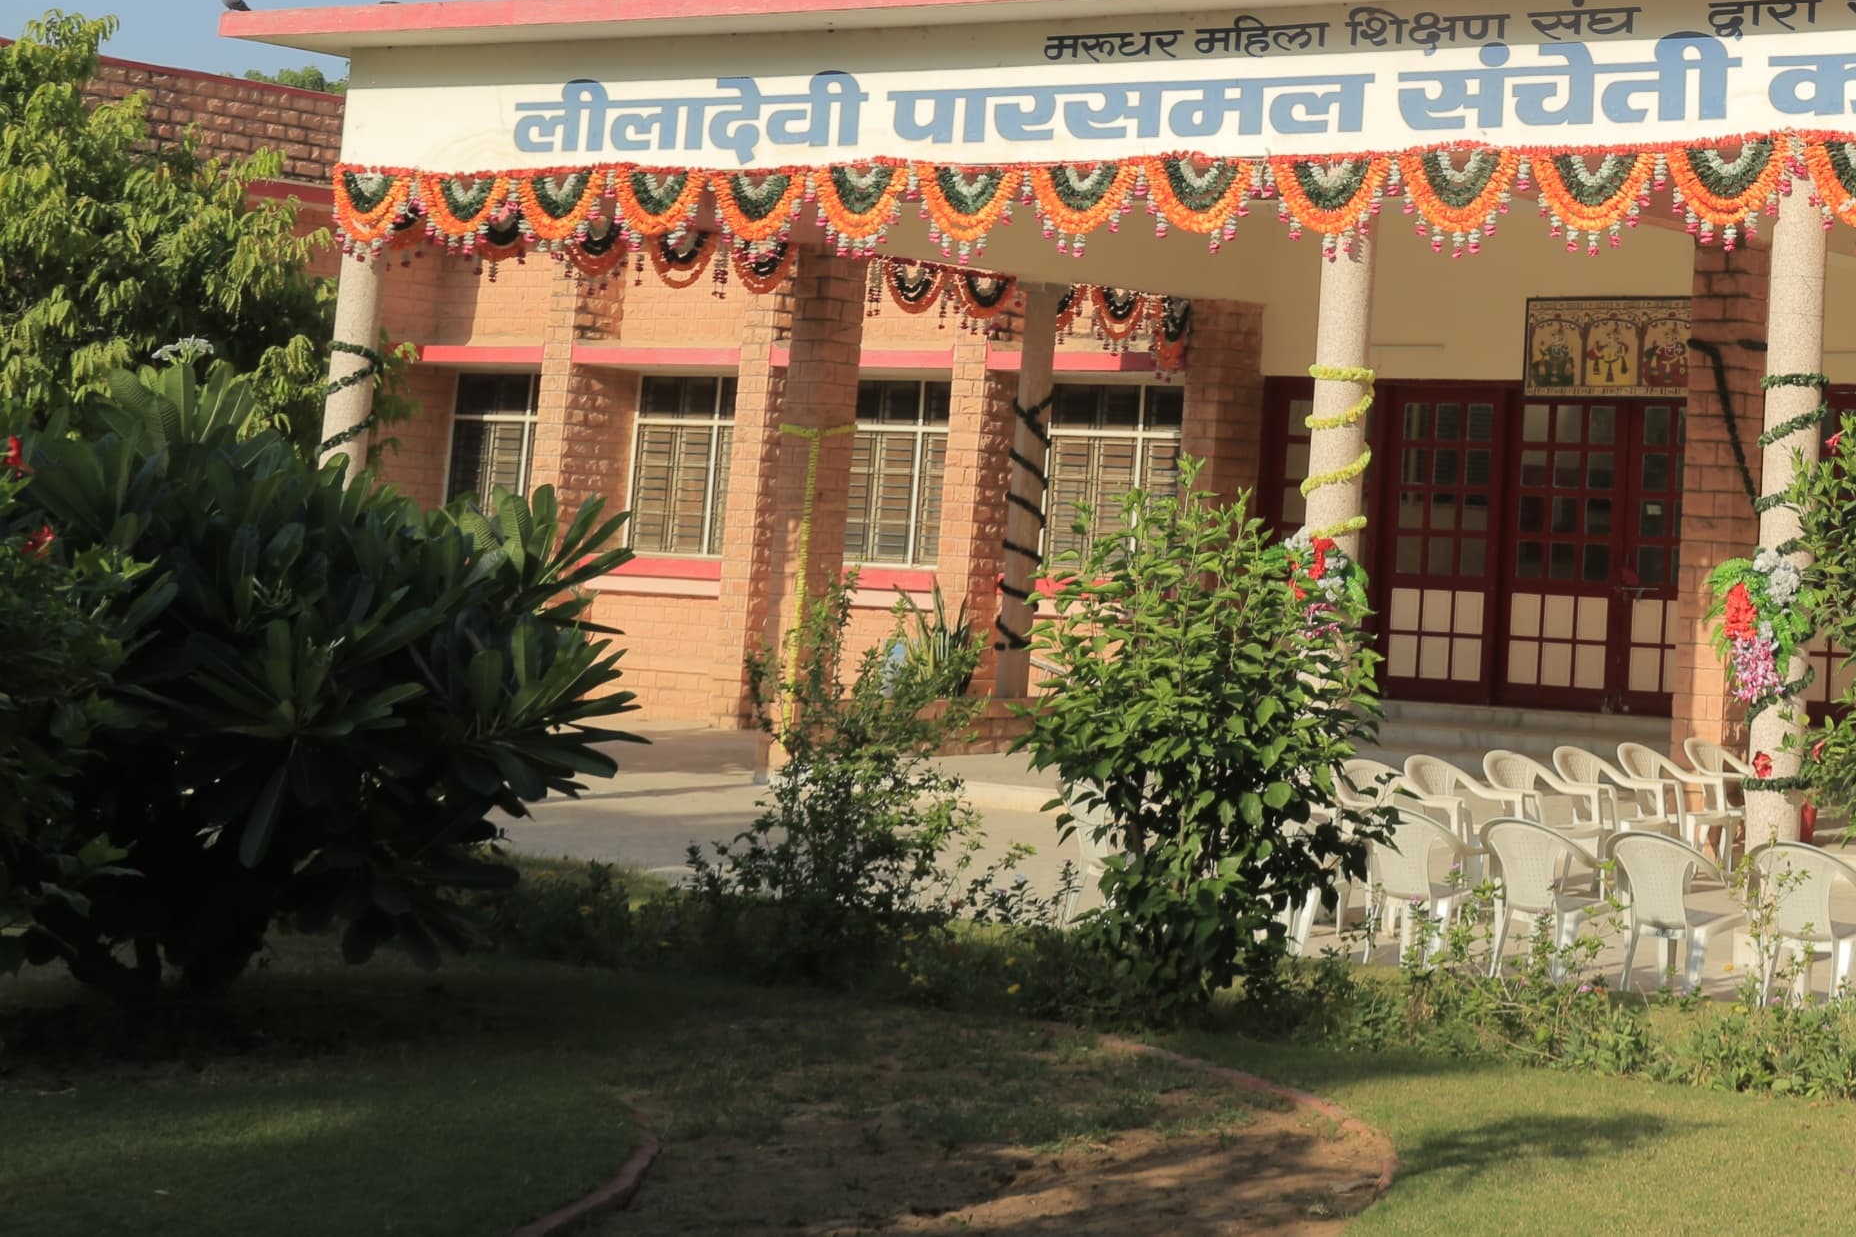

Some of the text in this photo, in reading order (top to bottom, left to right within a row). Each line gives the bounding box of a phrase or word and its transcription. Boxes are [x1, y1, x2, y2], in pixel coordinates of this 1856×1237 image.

[1194, 14, 1330, 58] महिला
[1344, 6, 1510, 56] शिक्षण
[513, 71, 867, 166] लीलादेवी
[888, 73, 1376, 143] पारसमल
[1398, 31, 1742, 131] संचेती
